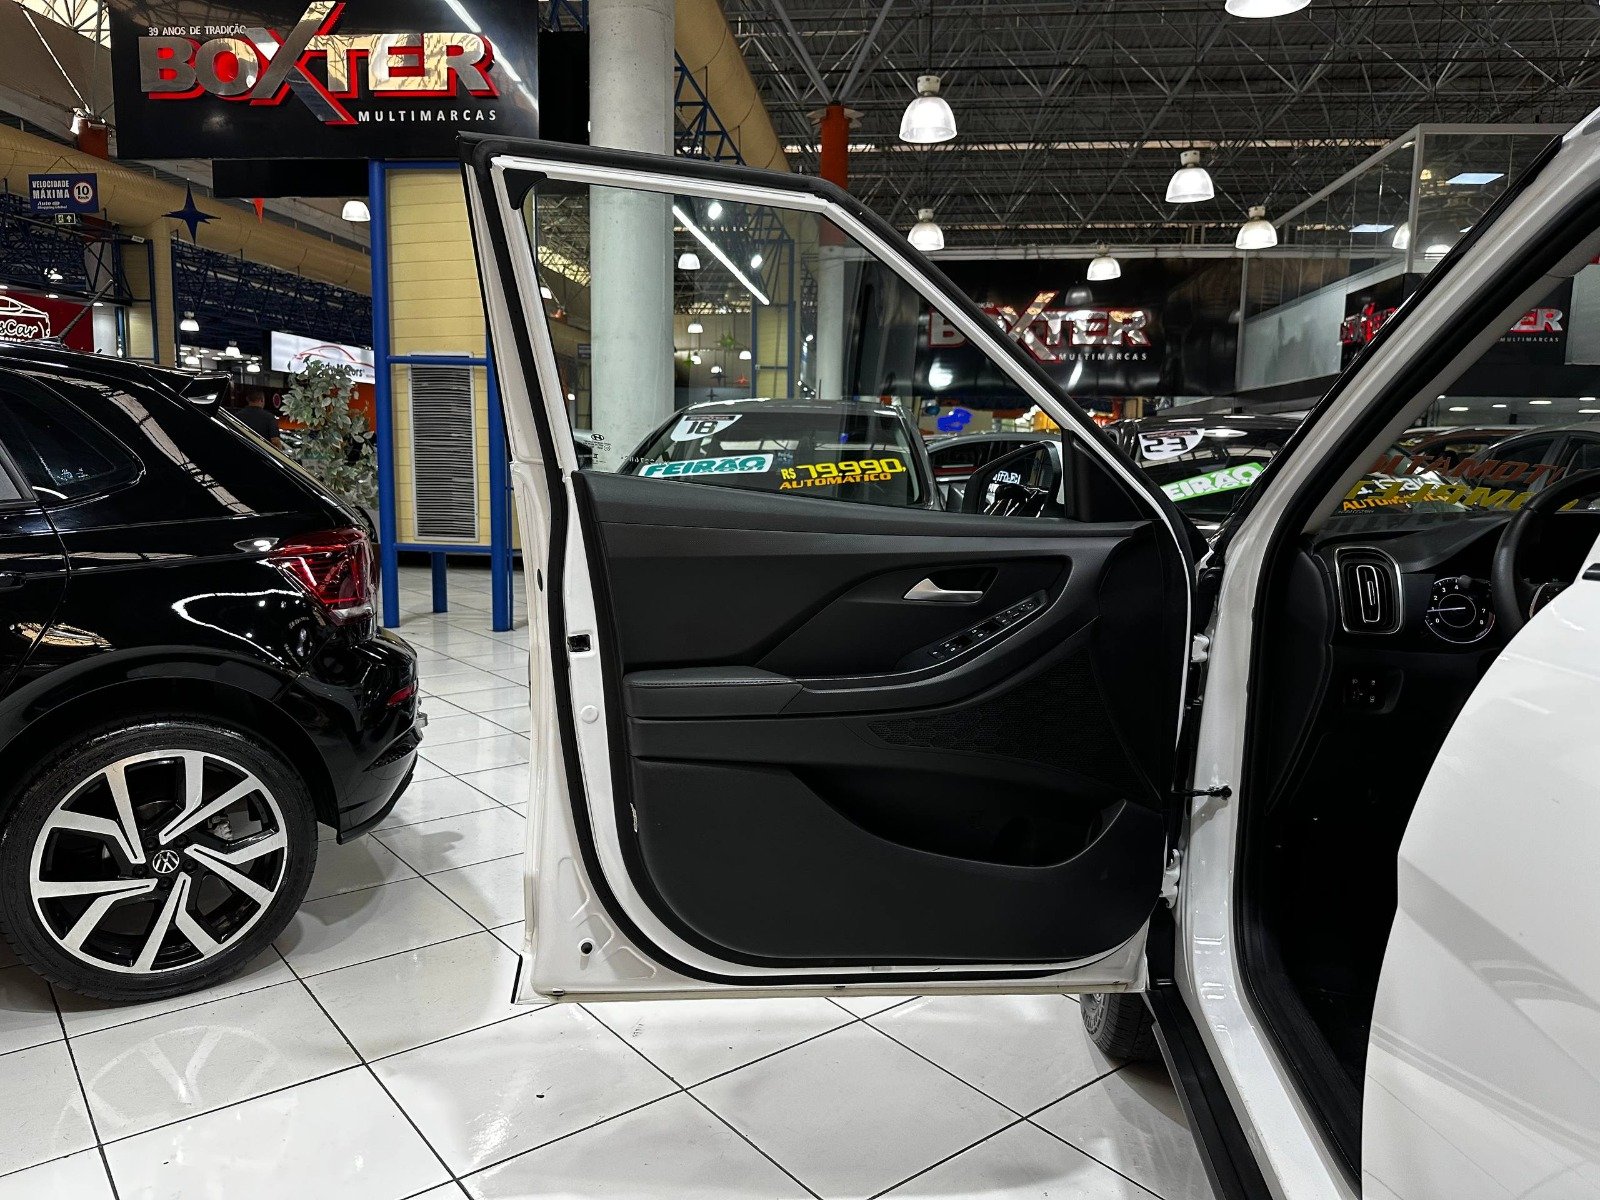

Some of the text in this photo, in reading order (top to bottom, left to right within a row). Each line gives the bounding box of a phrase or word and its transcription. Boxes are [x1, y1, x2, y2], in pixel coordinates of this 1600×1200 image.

[149, 23, 246, 36] 39 ANOS DE TRADIÇÃO
[138, 0, 500, 124] BOXTER
[358, 109, 497, 122] MULTIMARCAS
[32, 188, 70, 199] MÁXIMA
[76, 186, 90, 196] 10
[929, 290, 1151, 363] BXTER
[1058, 352, 1148, 361] MULTIMARCAS
[686, 420, 719, 435] 18
[1144, 436, 1189, 453] 23
[1162, 466, 1262, 501] EIRÃO
